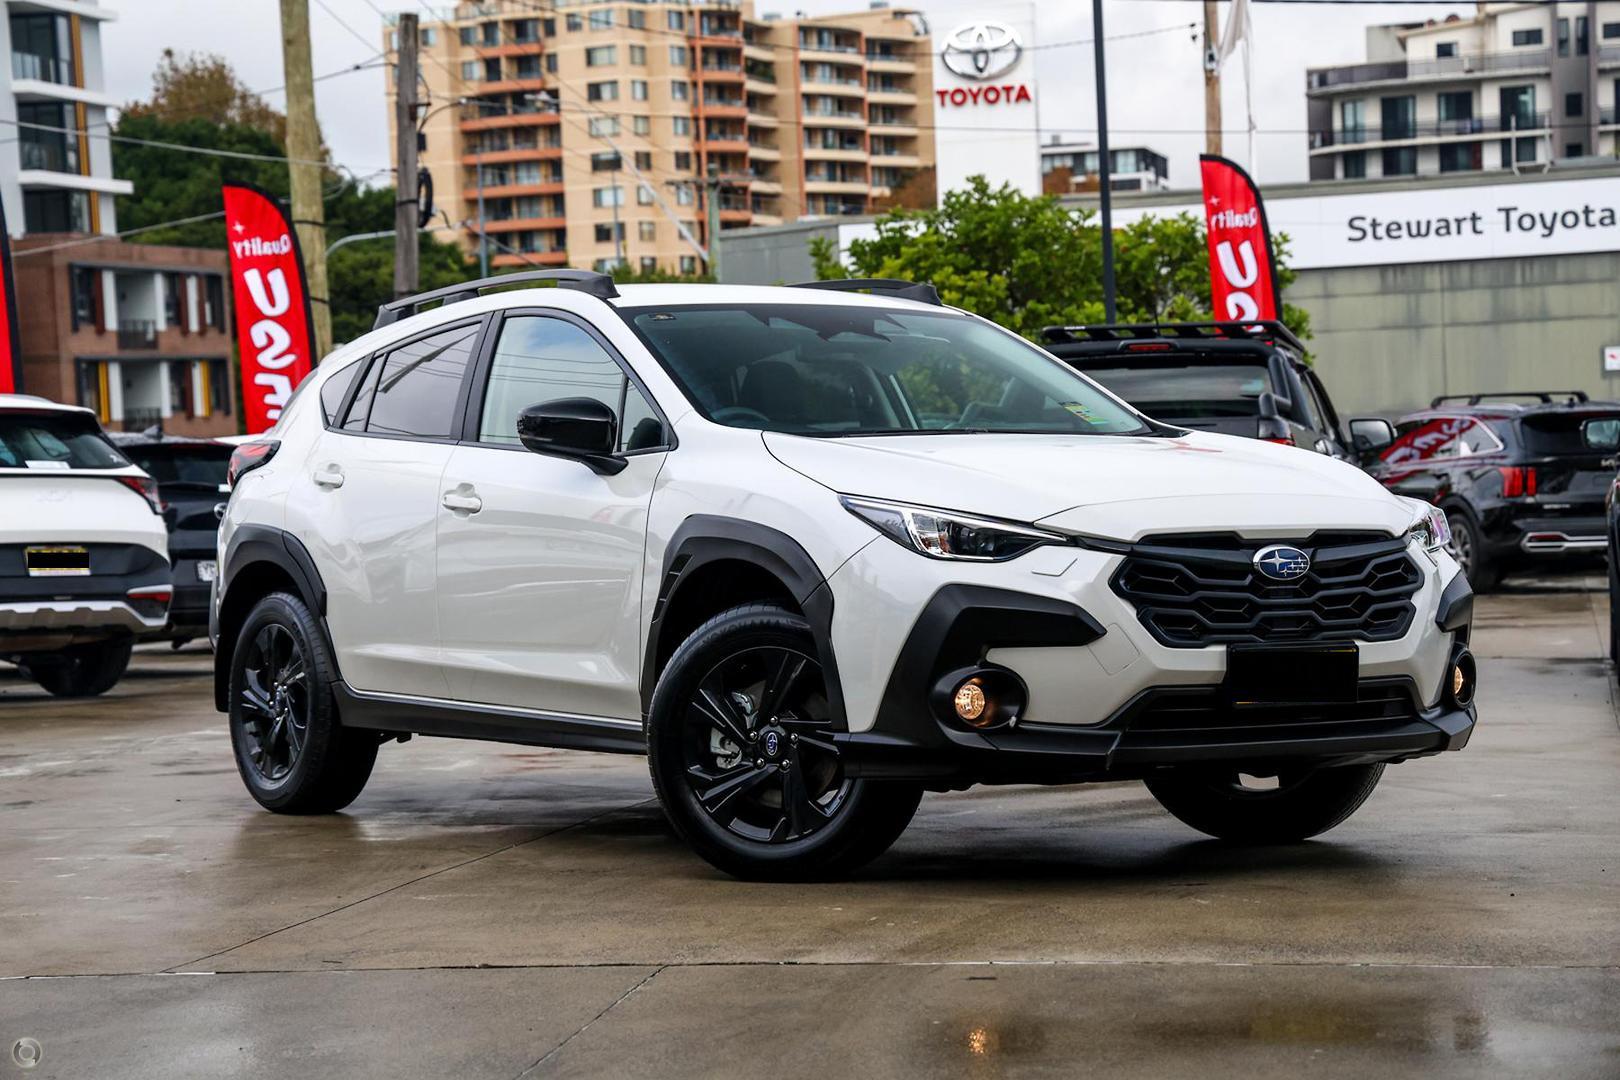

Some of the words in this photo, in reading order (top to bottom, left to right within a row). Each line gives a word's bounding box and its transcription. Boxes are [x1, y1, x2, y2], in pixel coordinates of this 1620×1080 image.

[936, 84, 1031, 107] TOYOTA
[1347, 212, 1483, 242] Stewart
[1497, 204, 1617, 237] Toyota
